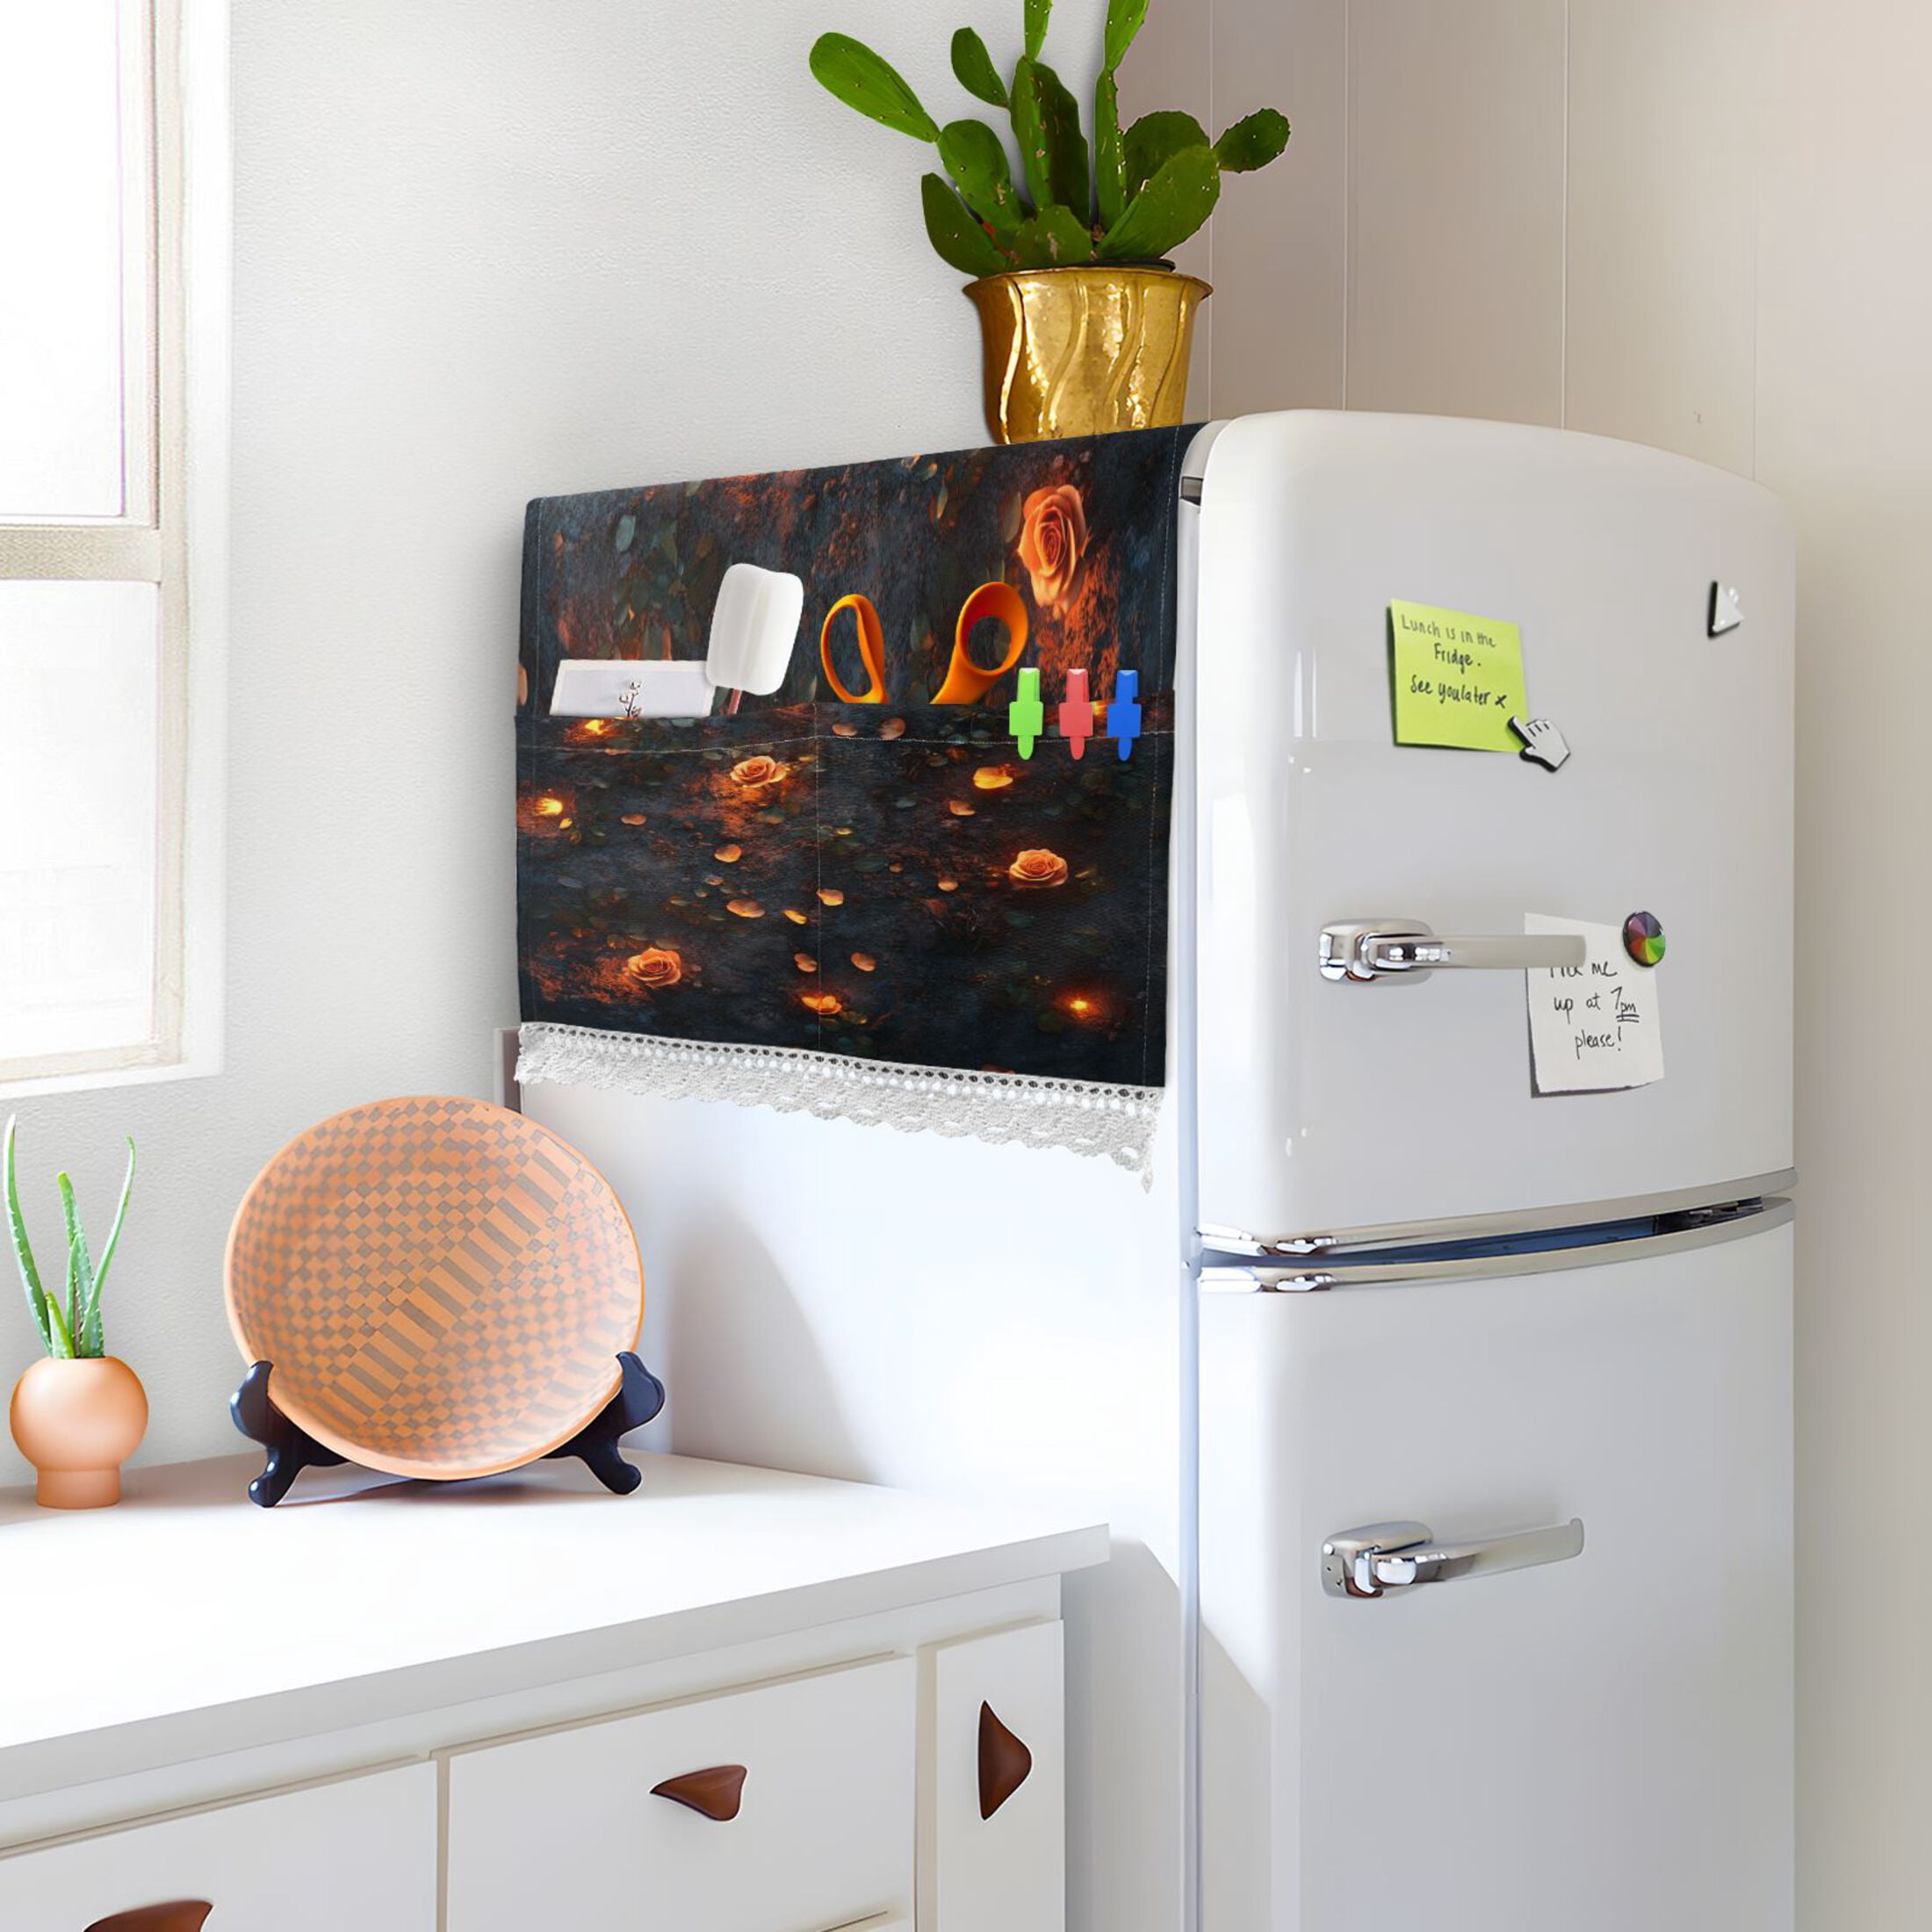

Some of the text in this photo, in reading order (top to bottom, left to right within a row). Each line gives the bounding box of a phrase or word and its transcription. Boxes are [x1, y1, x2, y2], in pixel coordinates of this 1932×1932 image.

[1401, 613, 1497, 648] Lunch is in the
[1410, 674, 1433, 695] See
[1553, 997, 1574, 1025] up
[1585, 992, 1602, 1011] at
[1574, 1025, 1623, 1061] please!
